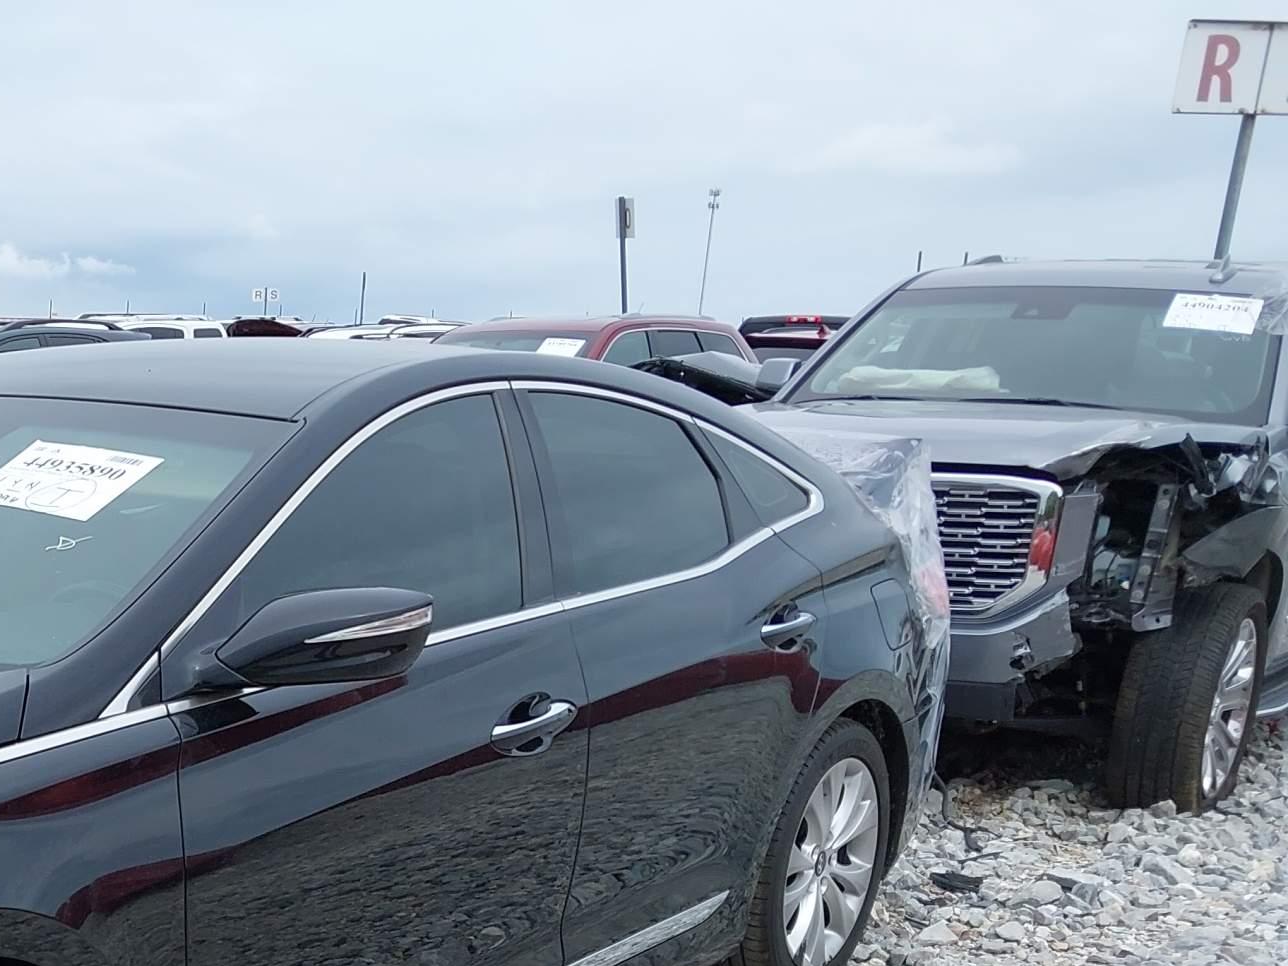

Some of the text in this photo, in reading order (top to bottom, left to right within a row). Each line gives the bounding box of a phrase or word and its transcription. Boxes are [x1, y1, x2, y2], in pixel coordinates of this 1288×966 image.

[1195, 33, 1241, 103] R
[254, 289, 278, 300] R S
[23, 456, 127, 481] 44935890
